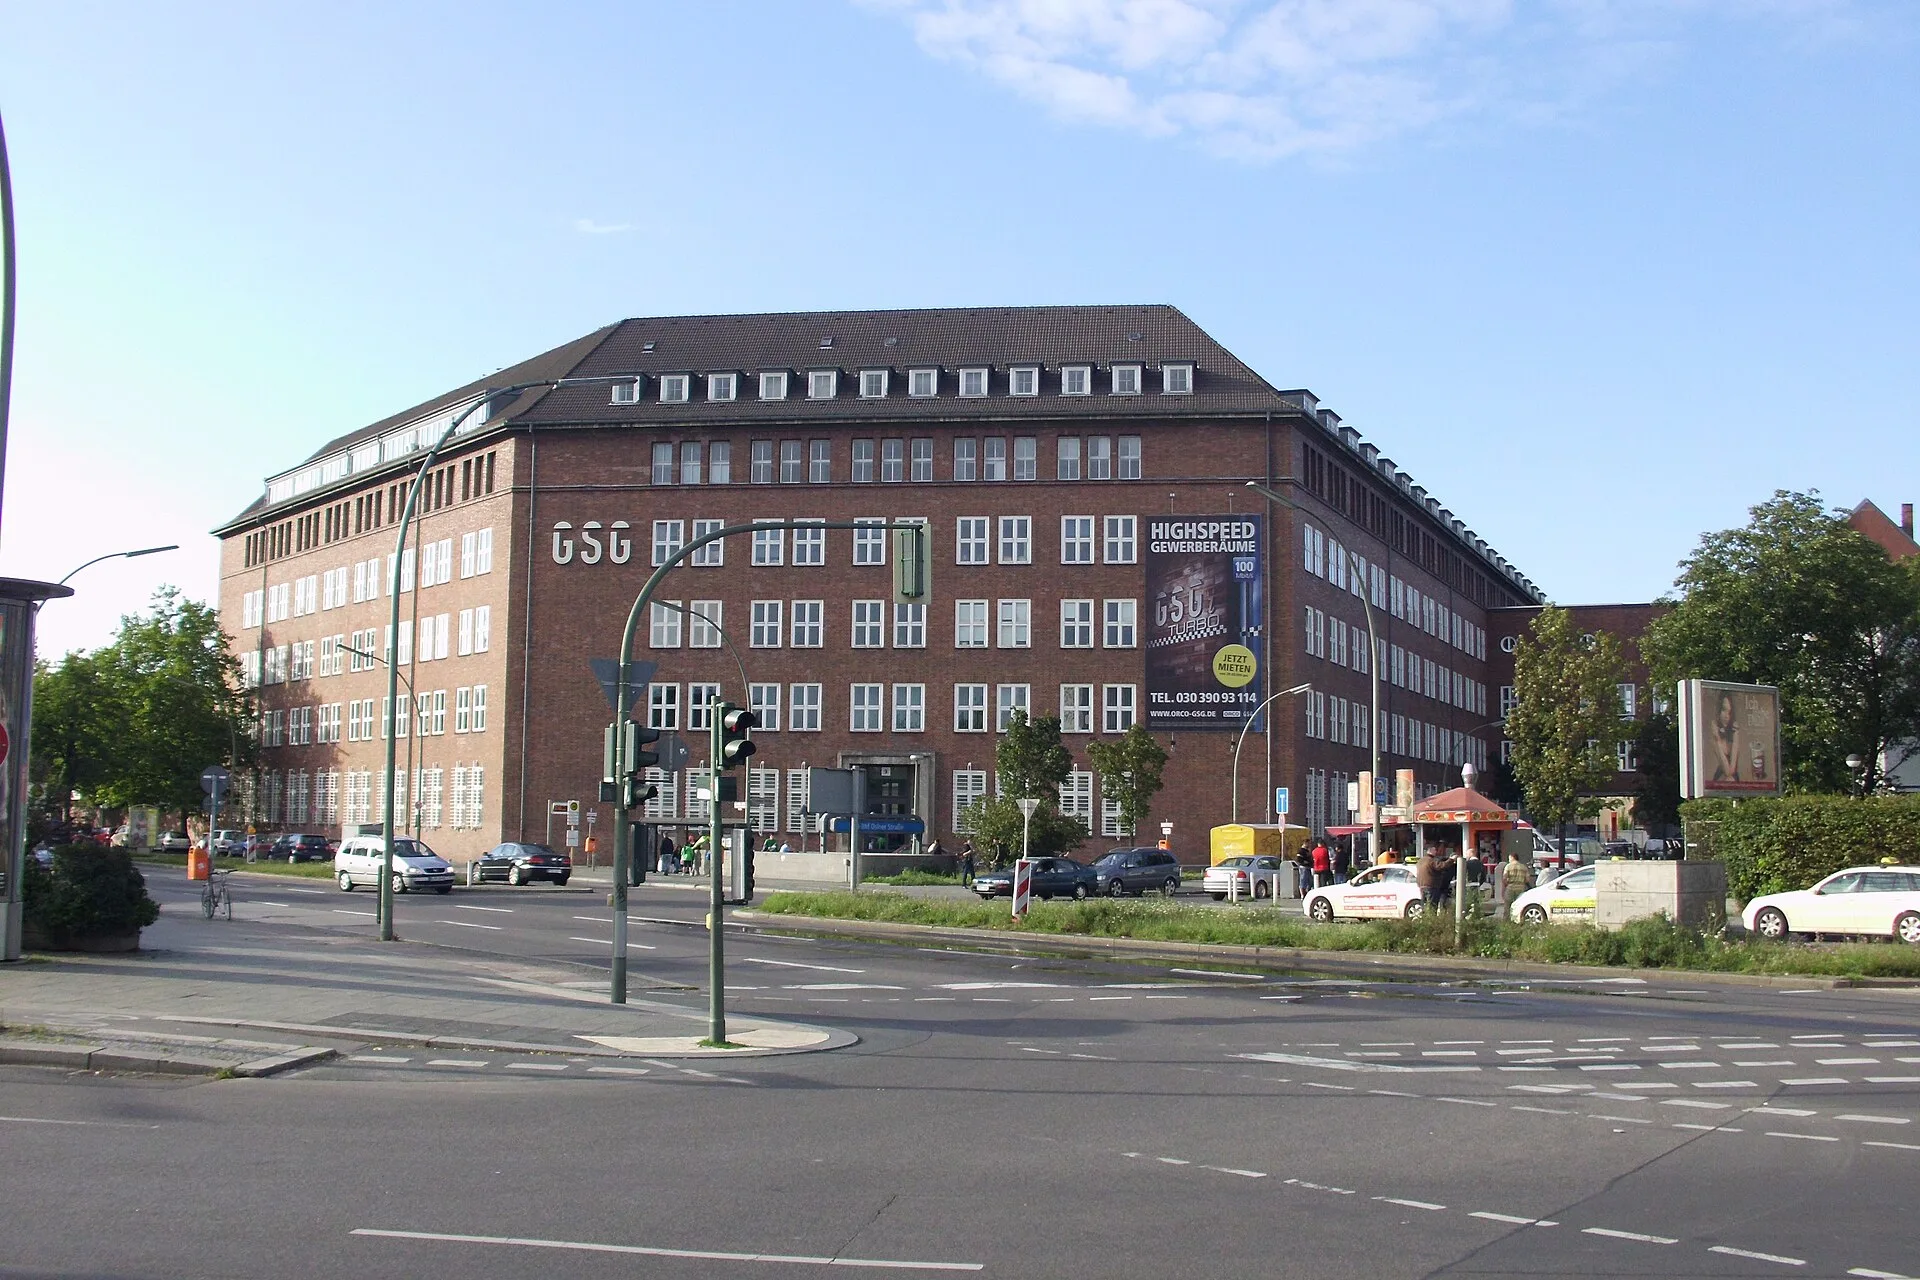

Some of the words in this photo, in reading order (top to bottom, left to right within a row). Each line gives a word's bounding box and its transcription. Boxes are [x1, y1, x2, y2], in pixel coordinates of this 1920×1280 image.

[1151, 522, 1255, 539] HIGHSPEED
[552, 520, 631, 565] GSG
[1150, 539, 1256, 553] GEWERBERÄUME
[1235, 561, 1254, 572] 100
[1155, 579, 1204, 627] GSG
[1168, 614, 1220, 637] TURBO
[1223, 654, 1247, 663] JETZT
[1218, 663, 1251, 673] MIETEN
[1150, 692, 1175, 703] TEL.
[1176, 692, 1198, 703] 030
[1198, 692, 1220, 703] 390
[1221, 692, 1236, 703] 93
[1237, 692, 1257, 703] 114
